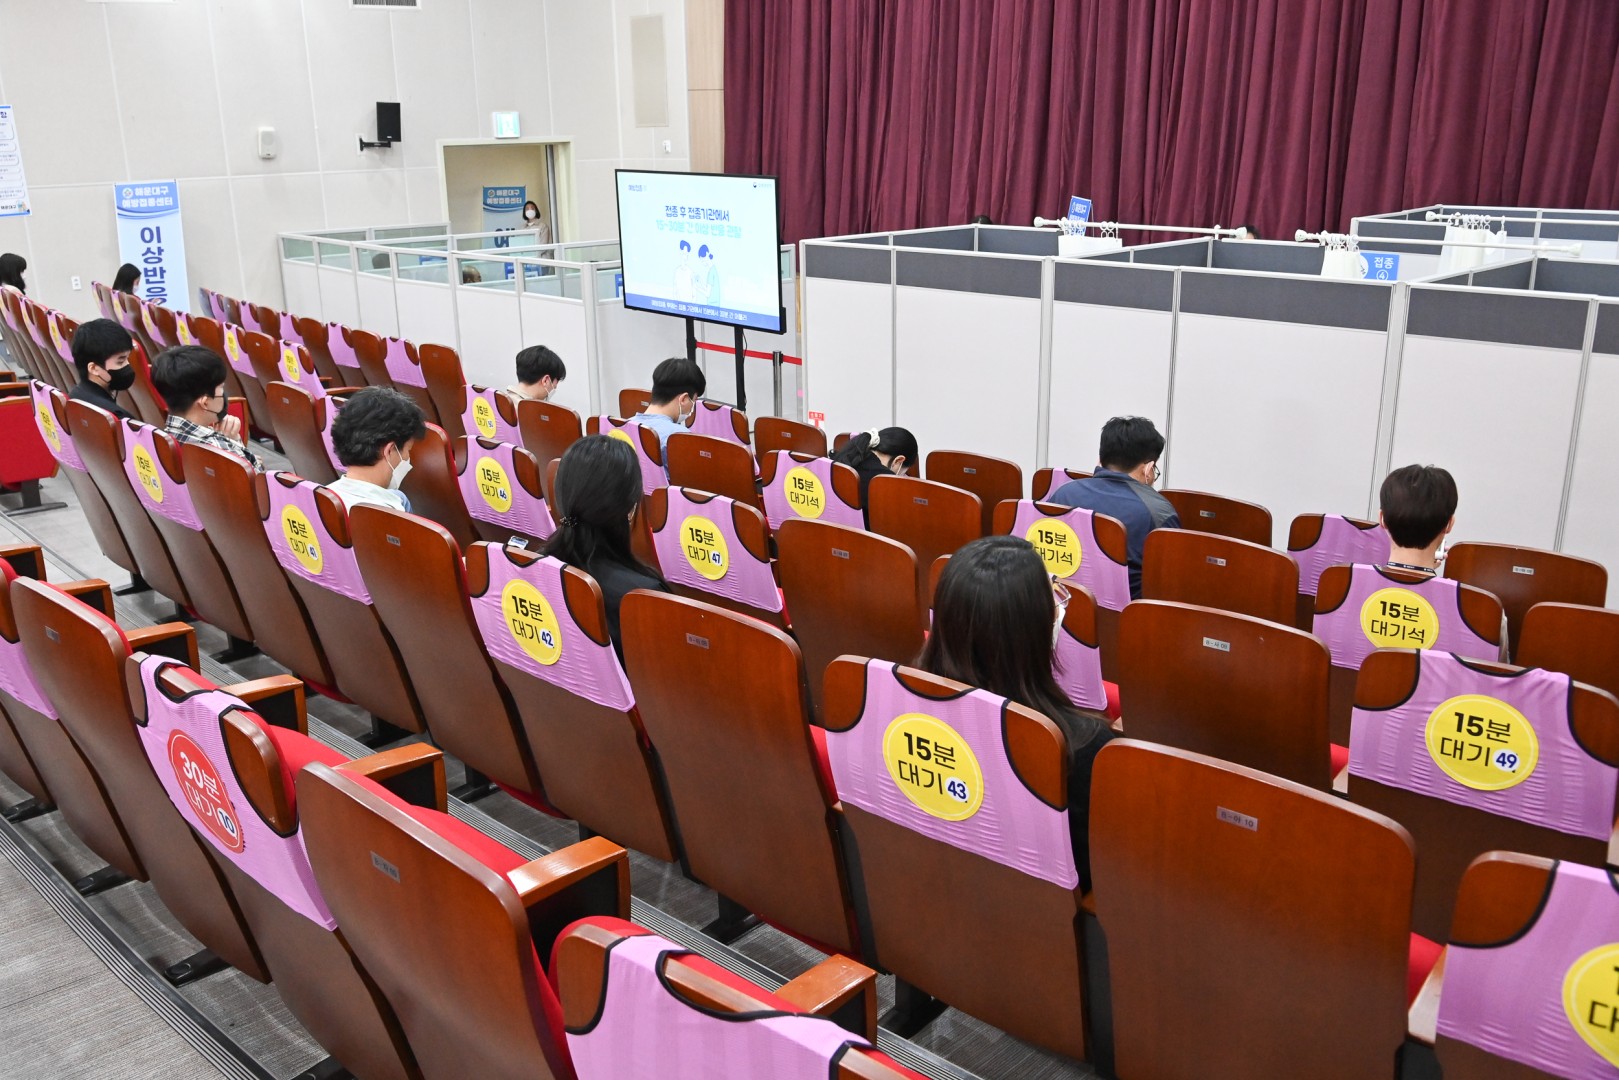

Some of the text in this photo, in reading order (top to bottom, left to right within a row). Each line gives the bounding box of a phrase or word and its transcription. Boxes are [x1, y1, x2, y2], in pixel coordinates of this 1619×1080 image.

[135, 186, 168, 196] 해운대구
[122, 197, 172, 208] 예방접종센터
[665, 206, 730, 222] 접종 후 접종기관에서
[1374, 256, 1394, 270] 접종
[476, 405, 488, 416] 15분
[136, 455, 151, 472] 15분
[482, 468, 500, 484] 15분
[792, 477, 814, 492] 15분
[482, 484, 499, 498] 대기
[790, 492, 820, 508] 대기석
[287, 518, 308, 538] 15분
[688, 528, 714, 546] 15분
[290, 538, 309, 557] 대기
[1038, 530, 1066, 547] 15분
[688, 546, 721, 564] 대기 47
[512, 596, 544, 622] 15분
[1380, 600, 1420, 622] 15분
[512, 618, 554, 646] 대기 42
[1371, 620, 1425, 644] 대기석
[1454, 712, 1512, 744] 15분
[904, 732, 956, 770] 15분
[1440, 736, 1518, 769] 대기 49
[180, 752, 221, 804] 30분
[898, 760, 966, 800] 대기 43
[185, 780, 234, 834] 대기 10
[1245, 818, 1254, 828] 10
